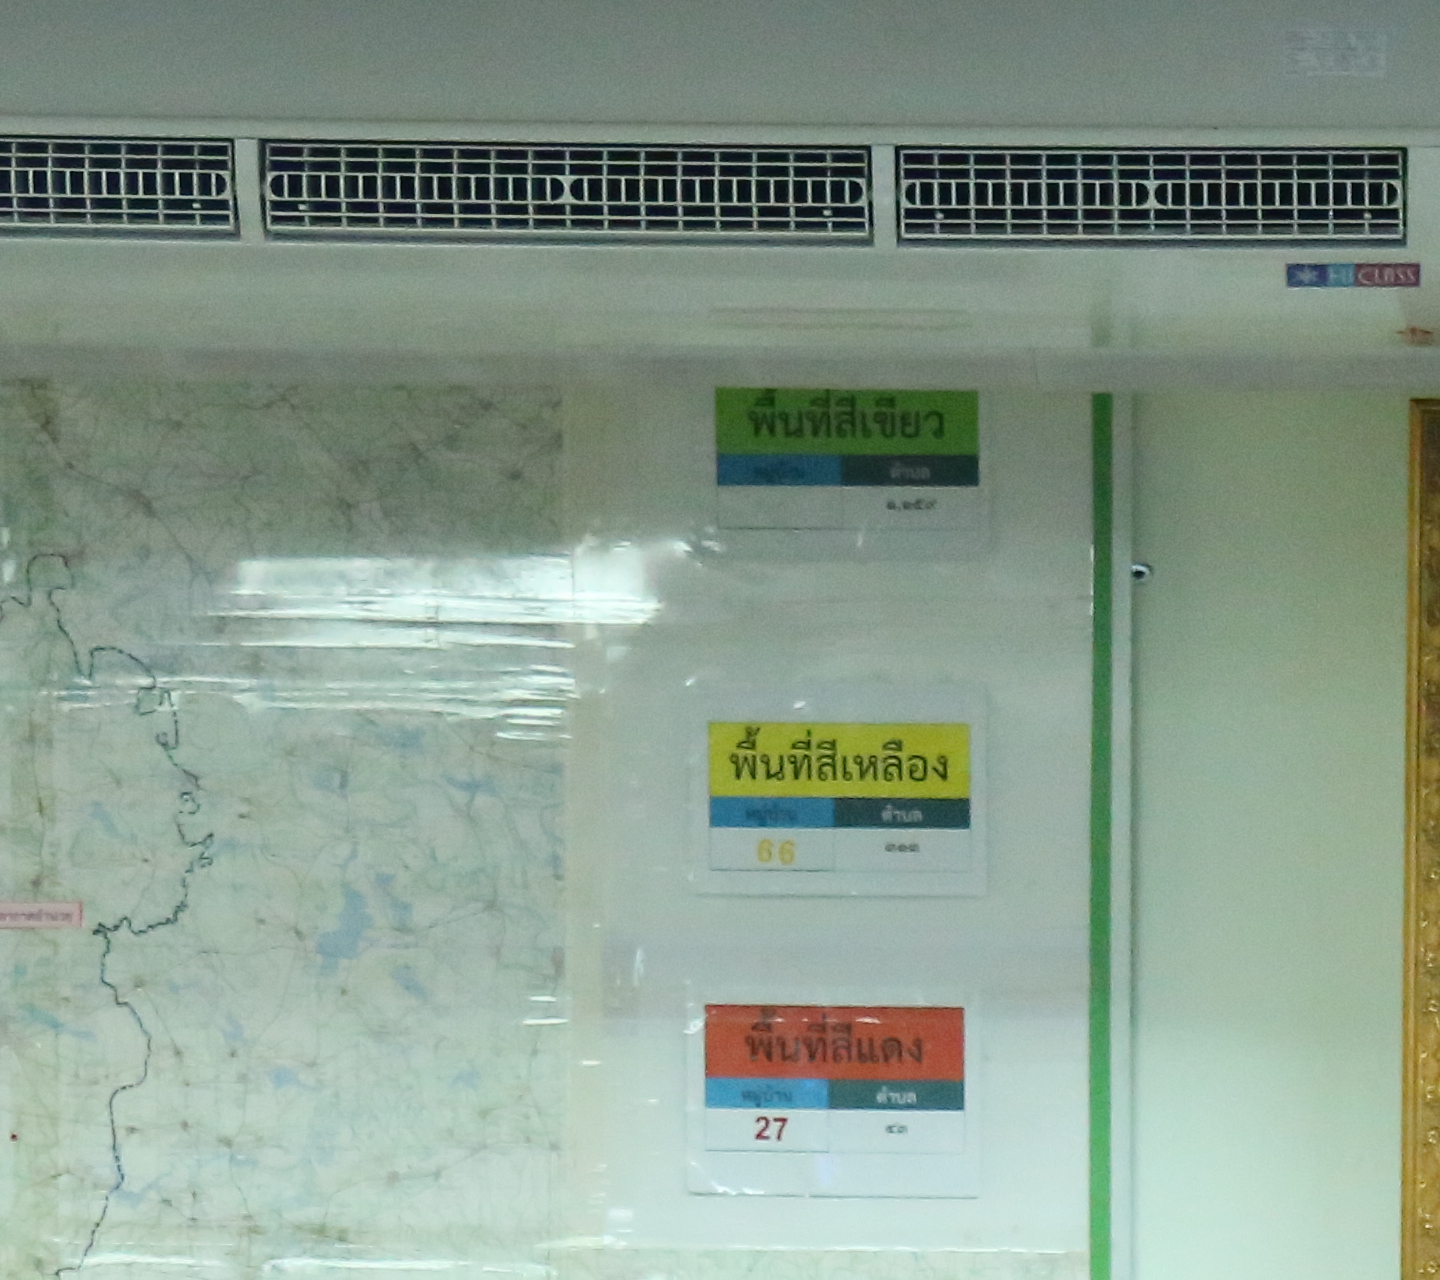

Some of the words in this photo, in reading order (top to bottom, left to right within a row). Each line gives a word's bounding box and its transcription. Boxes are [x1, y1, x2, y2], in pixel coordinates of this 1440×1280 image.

[747, 387, 946, 439] พื้นที่สีเขียว
[728, 724, 950, 783] พื้นที่สีเหลือง
[756, 838, 797, 865] 66
[744, 1009, 924, 1065] พื้นที่สีแดง
[754, 1116, 789, 1141] 27
